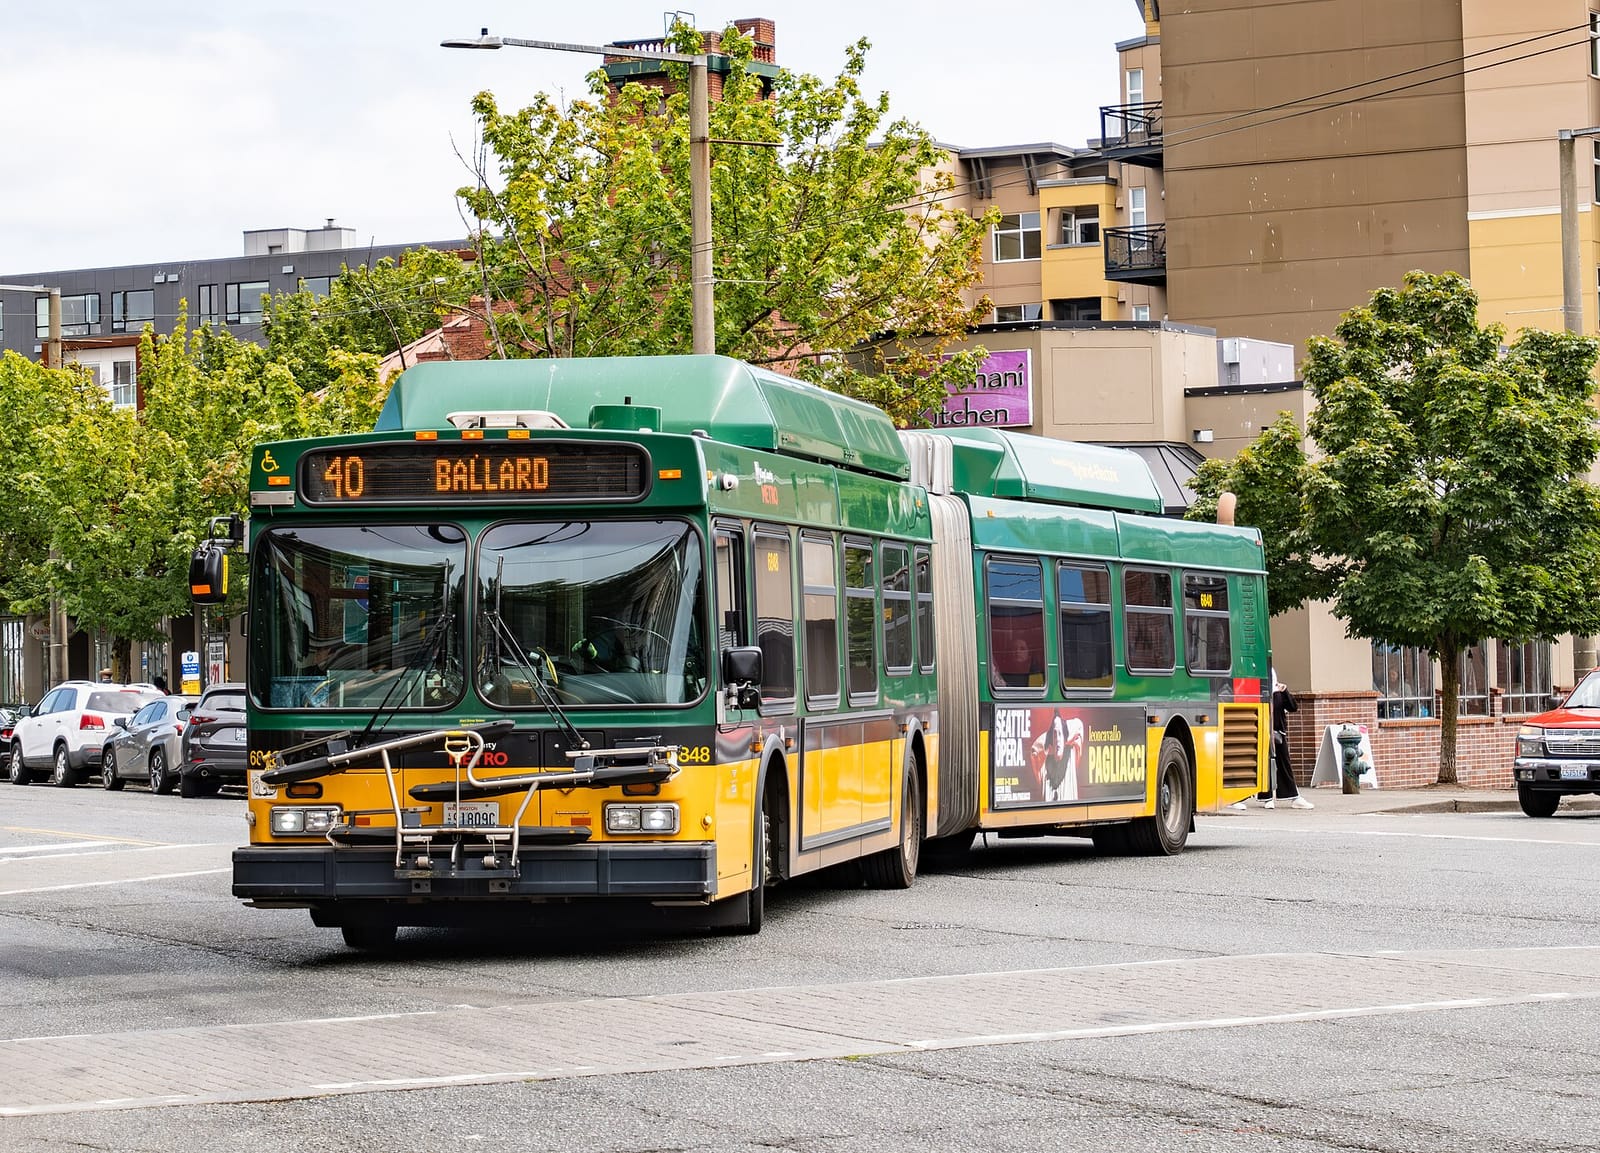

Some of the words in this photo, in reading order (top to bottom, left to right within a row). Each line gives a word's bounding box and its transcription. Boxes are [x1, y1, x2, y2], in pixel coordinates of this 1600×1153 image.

[324, 456, 364, 497] 40
[436, 458, 549, 491] BALLARD
[996, 709, 1030, 738] SEATTLE
[667, 746, 710, 763] 848
[996, 738, 1026, 767] OPERA.
[1088, 744, 1145, 783] PAGLIACCI
